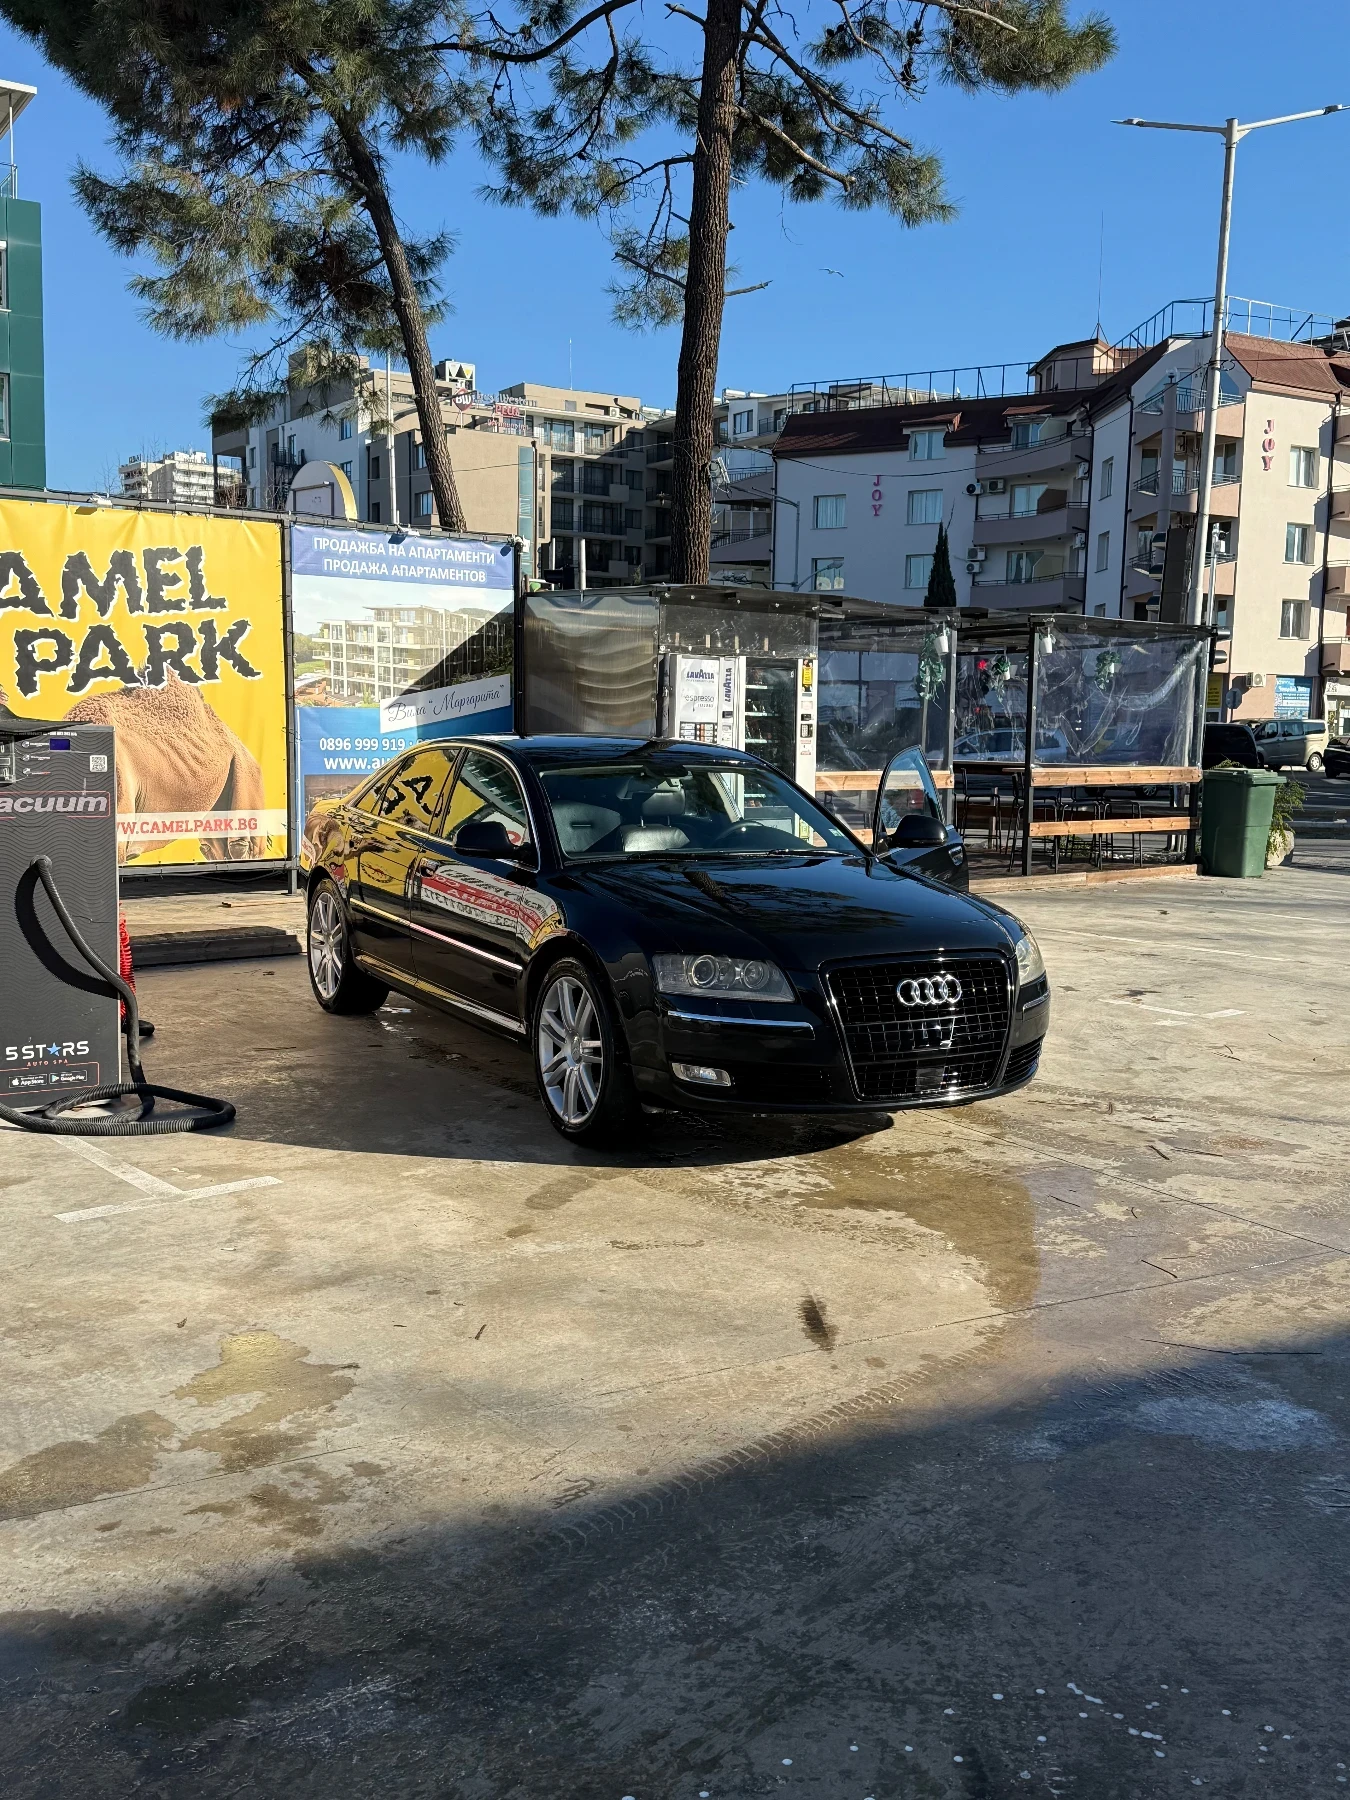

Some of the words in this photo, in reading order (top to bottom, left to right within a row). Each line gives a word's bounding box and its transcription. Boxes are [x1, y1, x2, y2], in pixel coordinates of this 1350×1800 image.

[1261, 419, 1275, 471] JOY
[871, 474, 882, 517] JOY
[313, 536, 386, 556] ПРОДАЖБА
[388, 544, 406, 557] НА
[408, 546, 496, 565] АПАРТАМЕНТИ
[323, 558, 389, 576] ПРОДАЖА
[391, 564, 487, 583] АПАРТАМЕНТОВ
[14, 619, 262, 697] PARK
[686, 668, 715, 680] LAVAZZA
[722, 667, 732, 703] LAVAZZA
[319, 737, 351, 751] 0896
[354, 738, 379, 751] 999
[381, 738, 405, 751] 919
